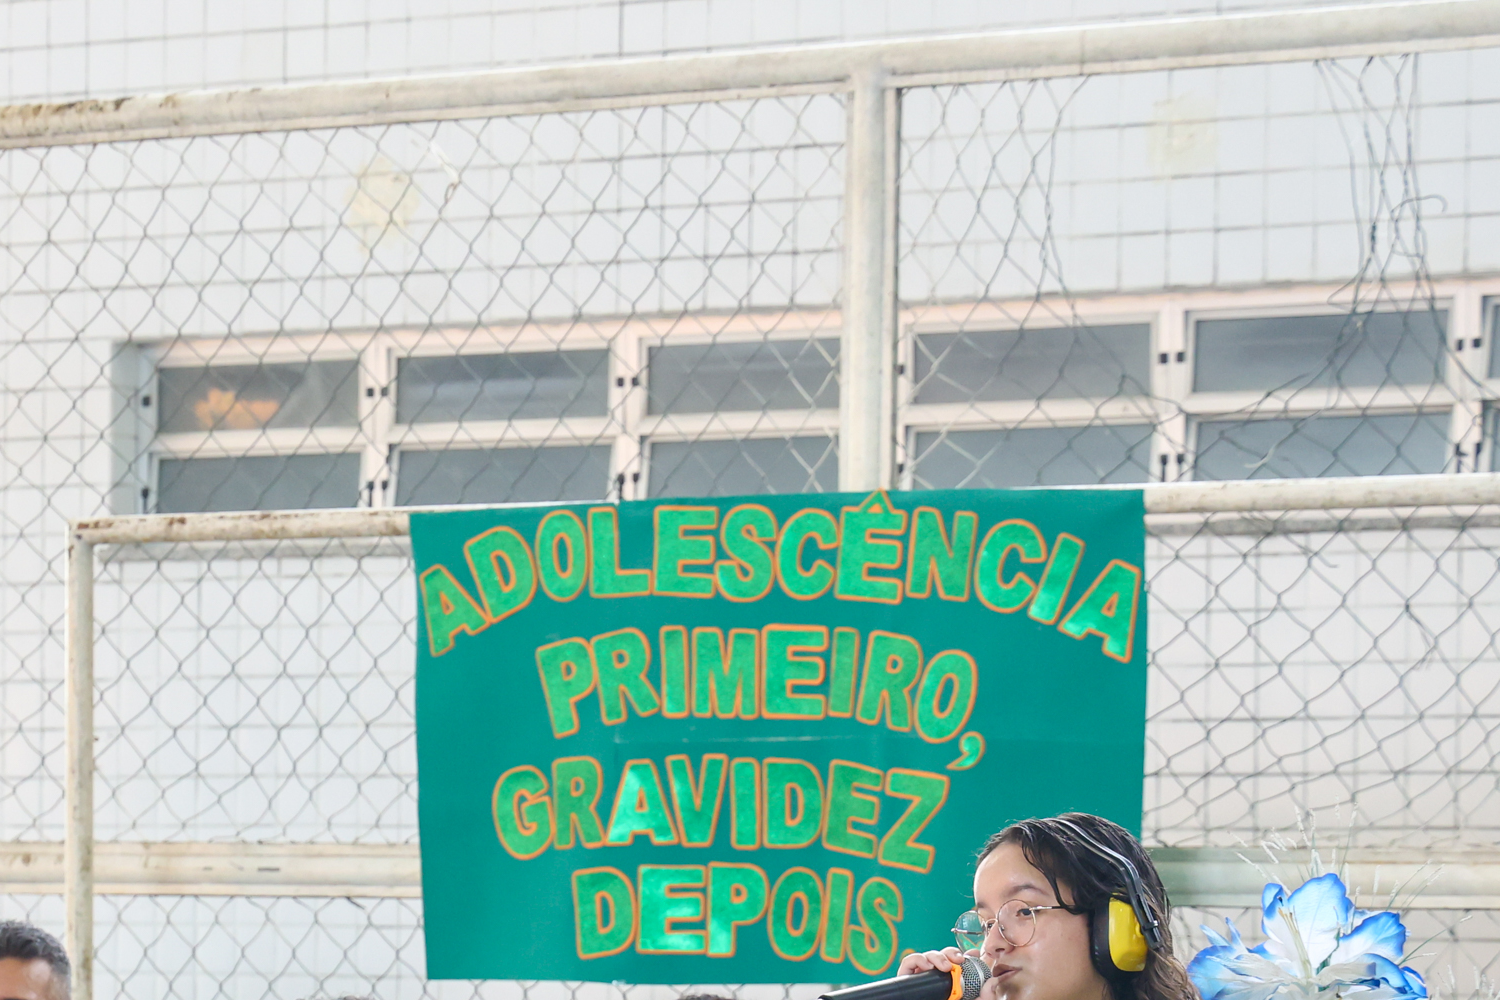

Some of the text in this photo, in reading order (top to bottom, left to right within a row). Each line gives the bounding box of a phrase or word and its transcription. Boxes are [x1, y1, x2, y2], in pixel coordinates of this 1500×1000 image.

[419, 488, 1141, 664] ADOLESCÊNCIA
[535, 623, 986, 771] PRIMEIRO,
[492, 753, 950, 874] GRAVIDEZ
[572, 863, 916, 976] DEPOIS
